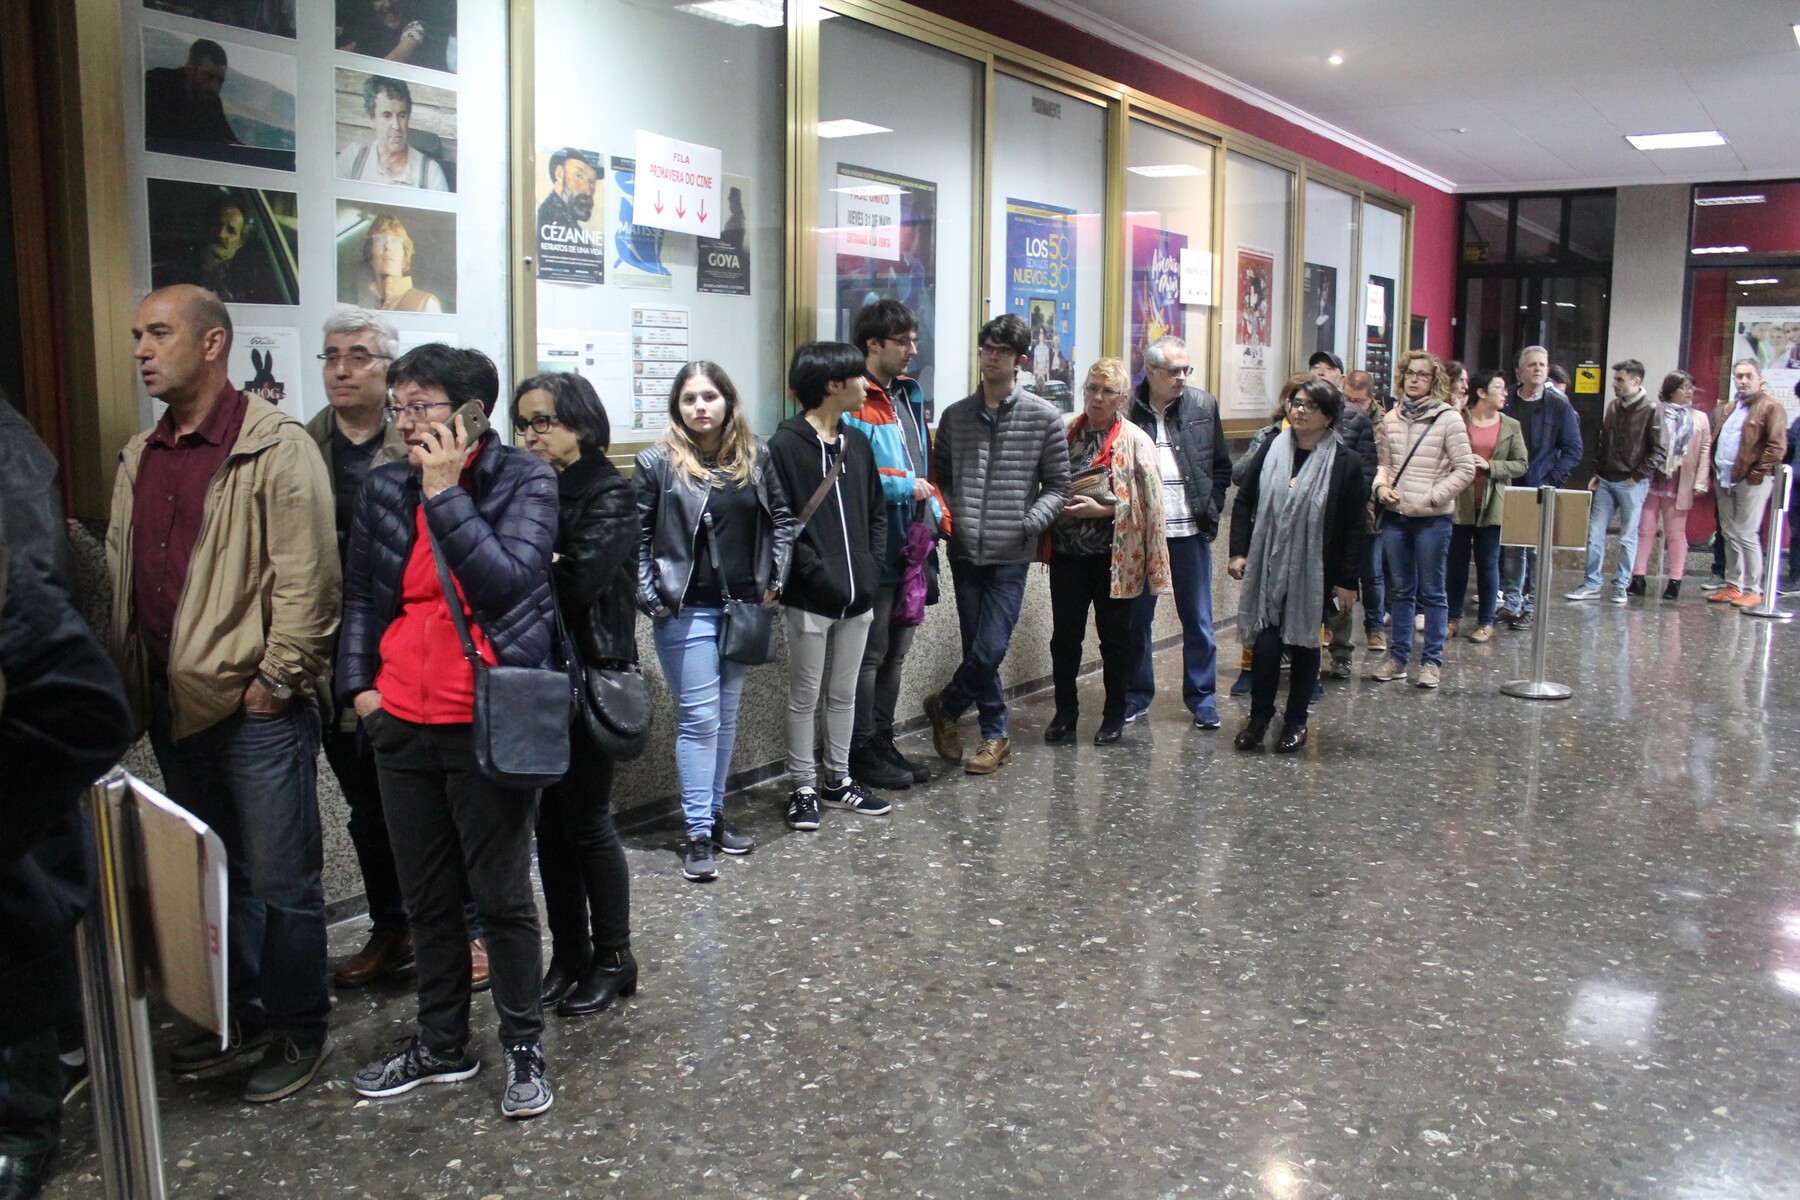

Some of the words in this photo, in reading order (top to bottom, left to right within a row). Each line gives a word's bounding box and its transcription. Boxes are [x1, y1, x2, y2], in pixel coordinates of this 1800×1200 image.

[673, 152, 690, 164] FILA
[650, 164, 684, 184] PRIMAVERA
[685, 172, 695, 186] DO
[696, 174, 712, 189] CINE
[540, 221, 603, 247] CÉZANNE
[619, 221, 664, 237] MATISSE
[540, 242, 568, 253] RETRATOS
[568, 245, 576, 253] DE
[576, 246, 590, 254] UNA
[590, 248, 603, 256] VIDA
[1026, 237, 1048, 258] LOS
[1049, 233, 1070, 261] 50
[708, 252, 740, 269] GOYA
[1026, 258, 1037, 268] SON
[1038, 259, 1048, 269] LOS
[1013, 267, 1048, 286] NUEVOS
[1049, 262, 1070, 290] 30
